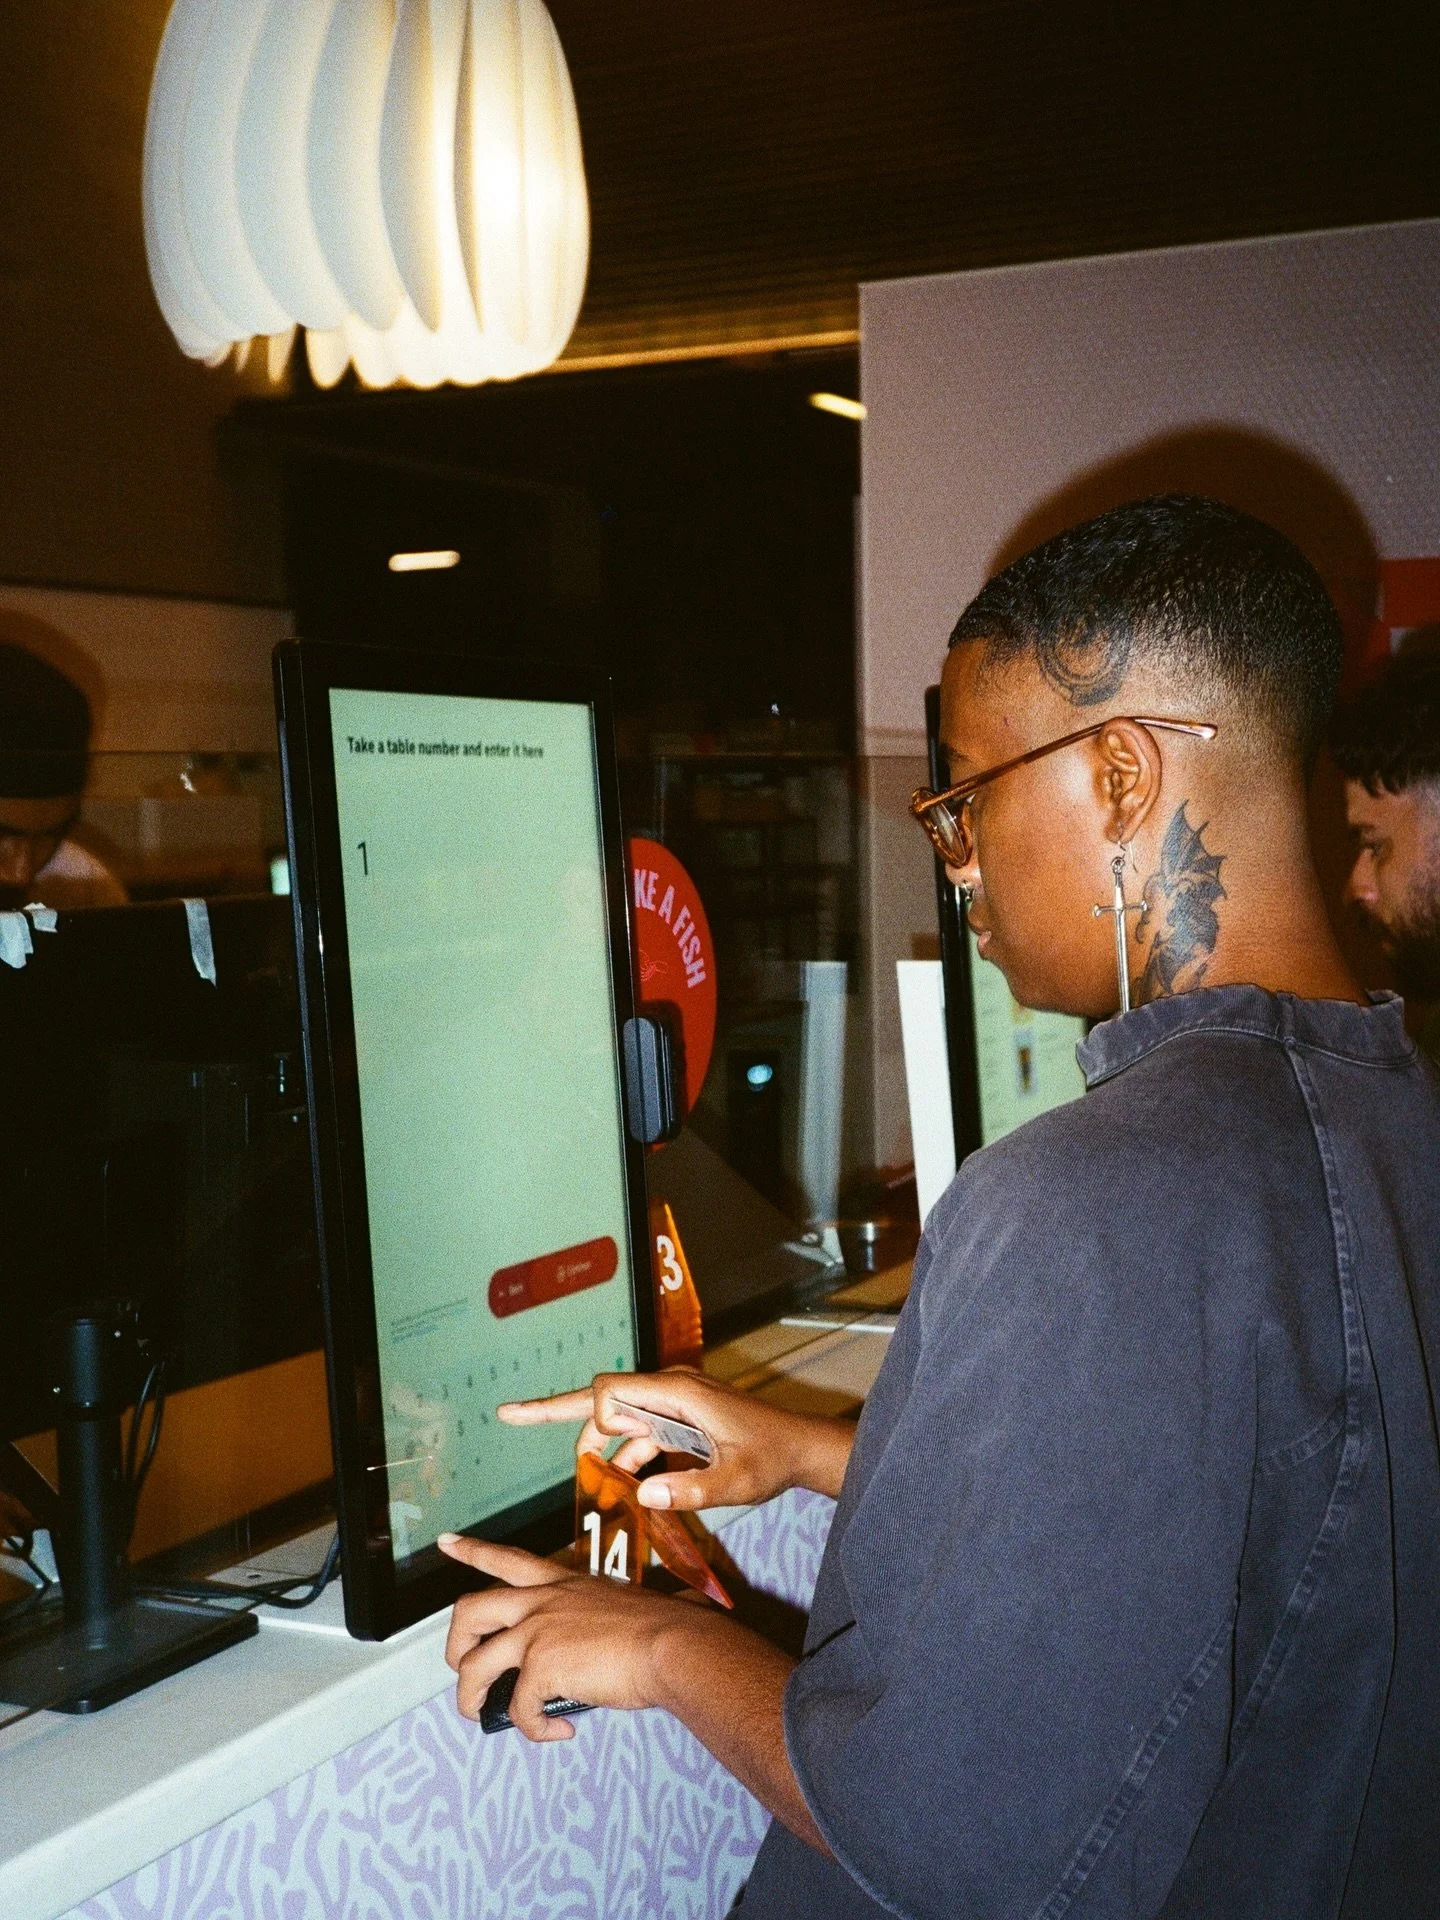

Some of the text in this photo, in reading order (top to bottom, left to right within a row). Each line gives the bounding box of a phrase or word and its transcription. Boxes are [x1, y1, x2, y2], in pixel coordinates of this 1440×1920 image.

[347, 736, 545, 759] Take a table number and enter it here
[357, 841, 368, 876] 1
[659, 885, 675, 923] A
[673, 905, 706, 987] FISH
[583, 1511, 631, 1582] 14
